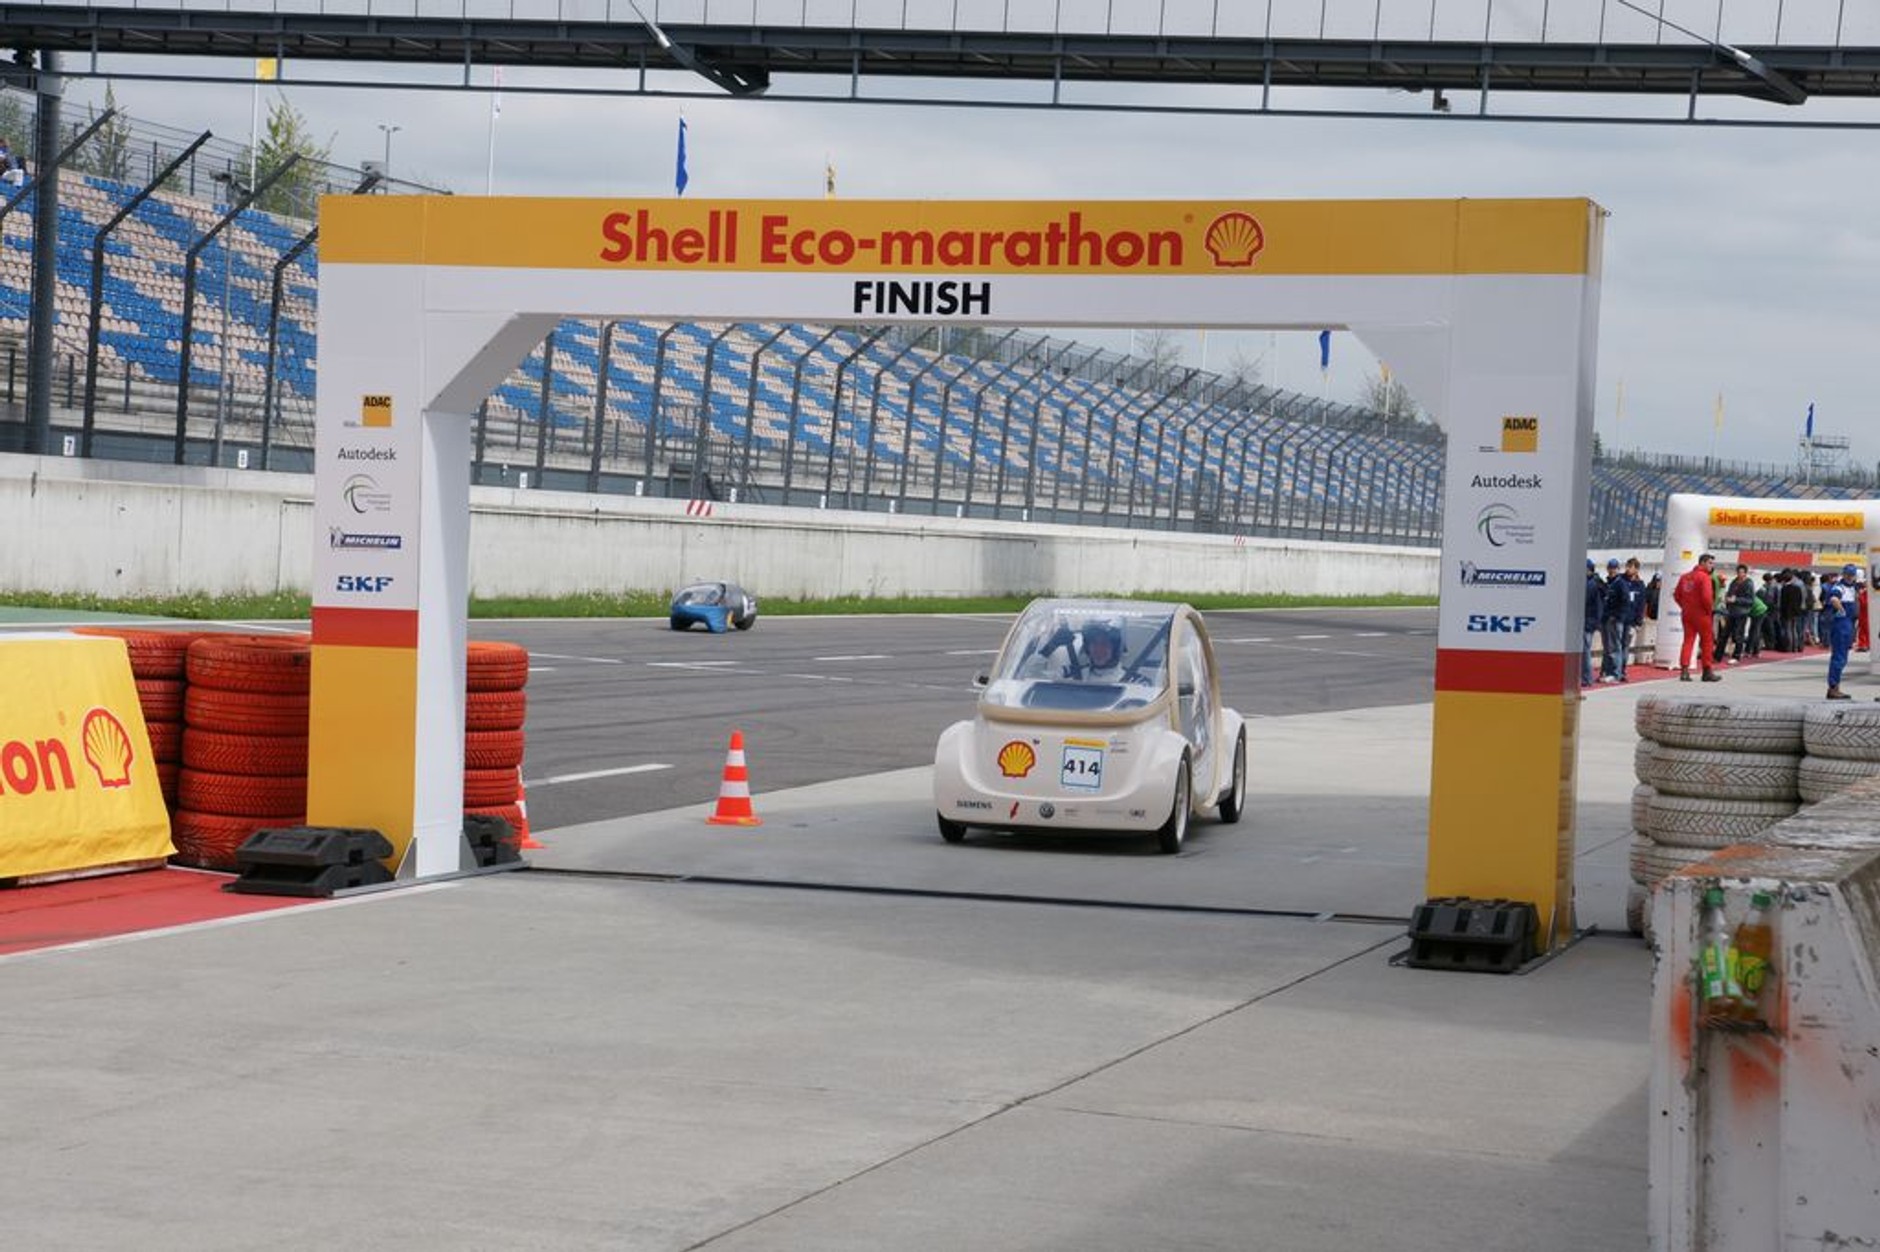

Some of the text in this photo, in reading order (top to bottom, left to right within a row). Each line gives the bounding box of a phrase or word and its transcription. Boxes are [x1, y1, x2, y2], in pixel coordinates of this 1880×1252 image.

[600, 209, 1183, 267] Shell Eco-marathon
[853, 281, 991, 315] FINISH
[363, 396, 391, 408] ADAC
[1503, 418, 1537, 430] ADAC
[338, 448, 396, 461] Autodesk
[1471, 474, 1542, 489] Autodesk
[1716, 512, 1840, 527] Shell Eco-marathon
[344, 536, 399, 546] MICHELIN
[336, 576, 394, 592] SKF
[1478, 572, 1543, 582] MICHELIN
[1467, 615, 1536, 633] SKF
[0, 738, 75, 795] on
[1064, 760, 1100, 775] 414
